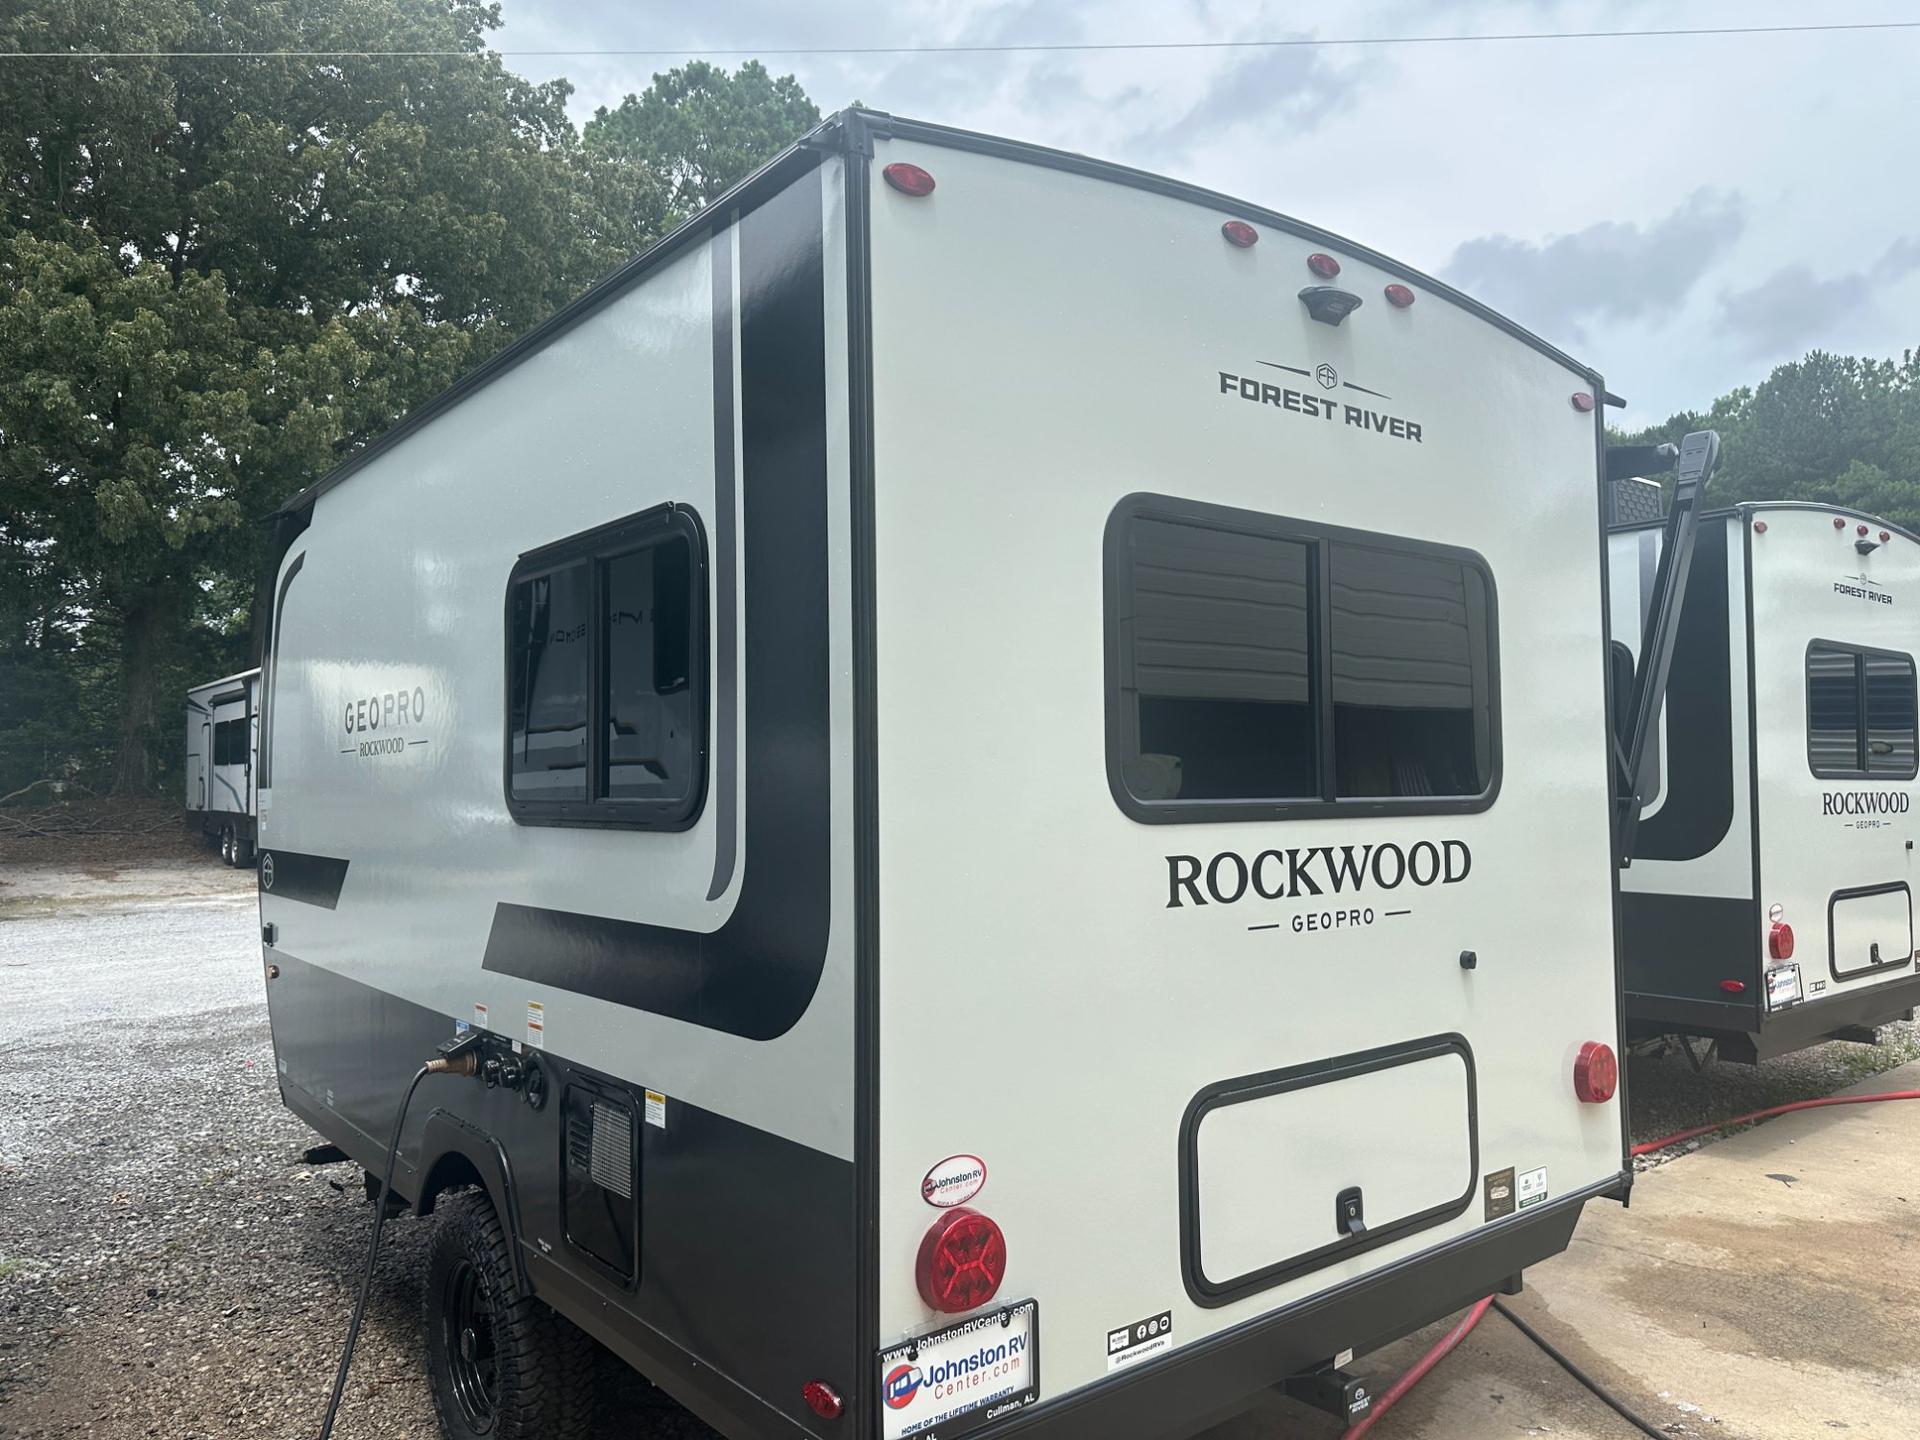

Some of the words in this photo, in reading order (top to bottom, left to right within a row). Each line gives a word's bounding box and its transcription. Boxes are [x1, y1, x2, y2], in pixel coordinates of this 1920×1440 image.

[1218, 371, 1337, 420] FOREST
[1343, 404, 1423, 443] RIVER
[1833, 582, 1867, 599] FOREST
[1868, 590, 1893, 605] RIVER
[344, 686, 425, 735] GEOPRO
[359, 737, 405, 757] ROCKWOOD
[1822, 792, 1910, 815] ROCKWOOD
[1855, 820, 1880, 829] GEOPRO
[1165, 839, 1473, 909] ROCKWOOD
[1291, 907, 1375, 933] GEOPRO
[936, 1172, 973, 1189] Johnston
[972, 1168, 983, 1179] RV
[882, 1302, 1035, 1362] www.JohnstonRVCente.com
[923, 1344, 1006, 1388] Johnston
[1008, 1331, 1028, 1357] RV
[934, 1356, 1020, 1400] Center.com
[901, 1421, 923, 1436] HOME
[923, 1417, 934, 1427] OF
[934, 1411, 949, 1424] THE
[949, 1401, 978, 1420] LIFETIME
[979, 1385, 1015, 1406] WARRANTY
[986, 1398, 1023, 1419] Cullman,
[1023, 1392, 1035, 1406] AL
